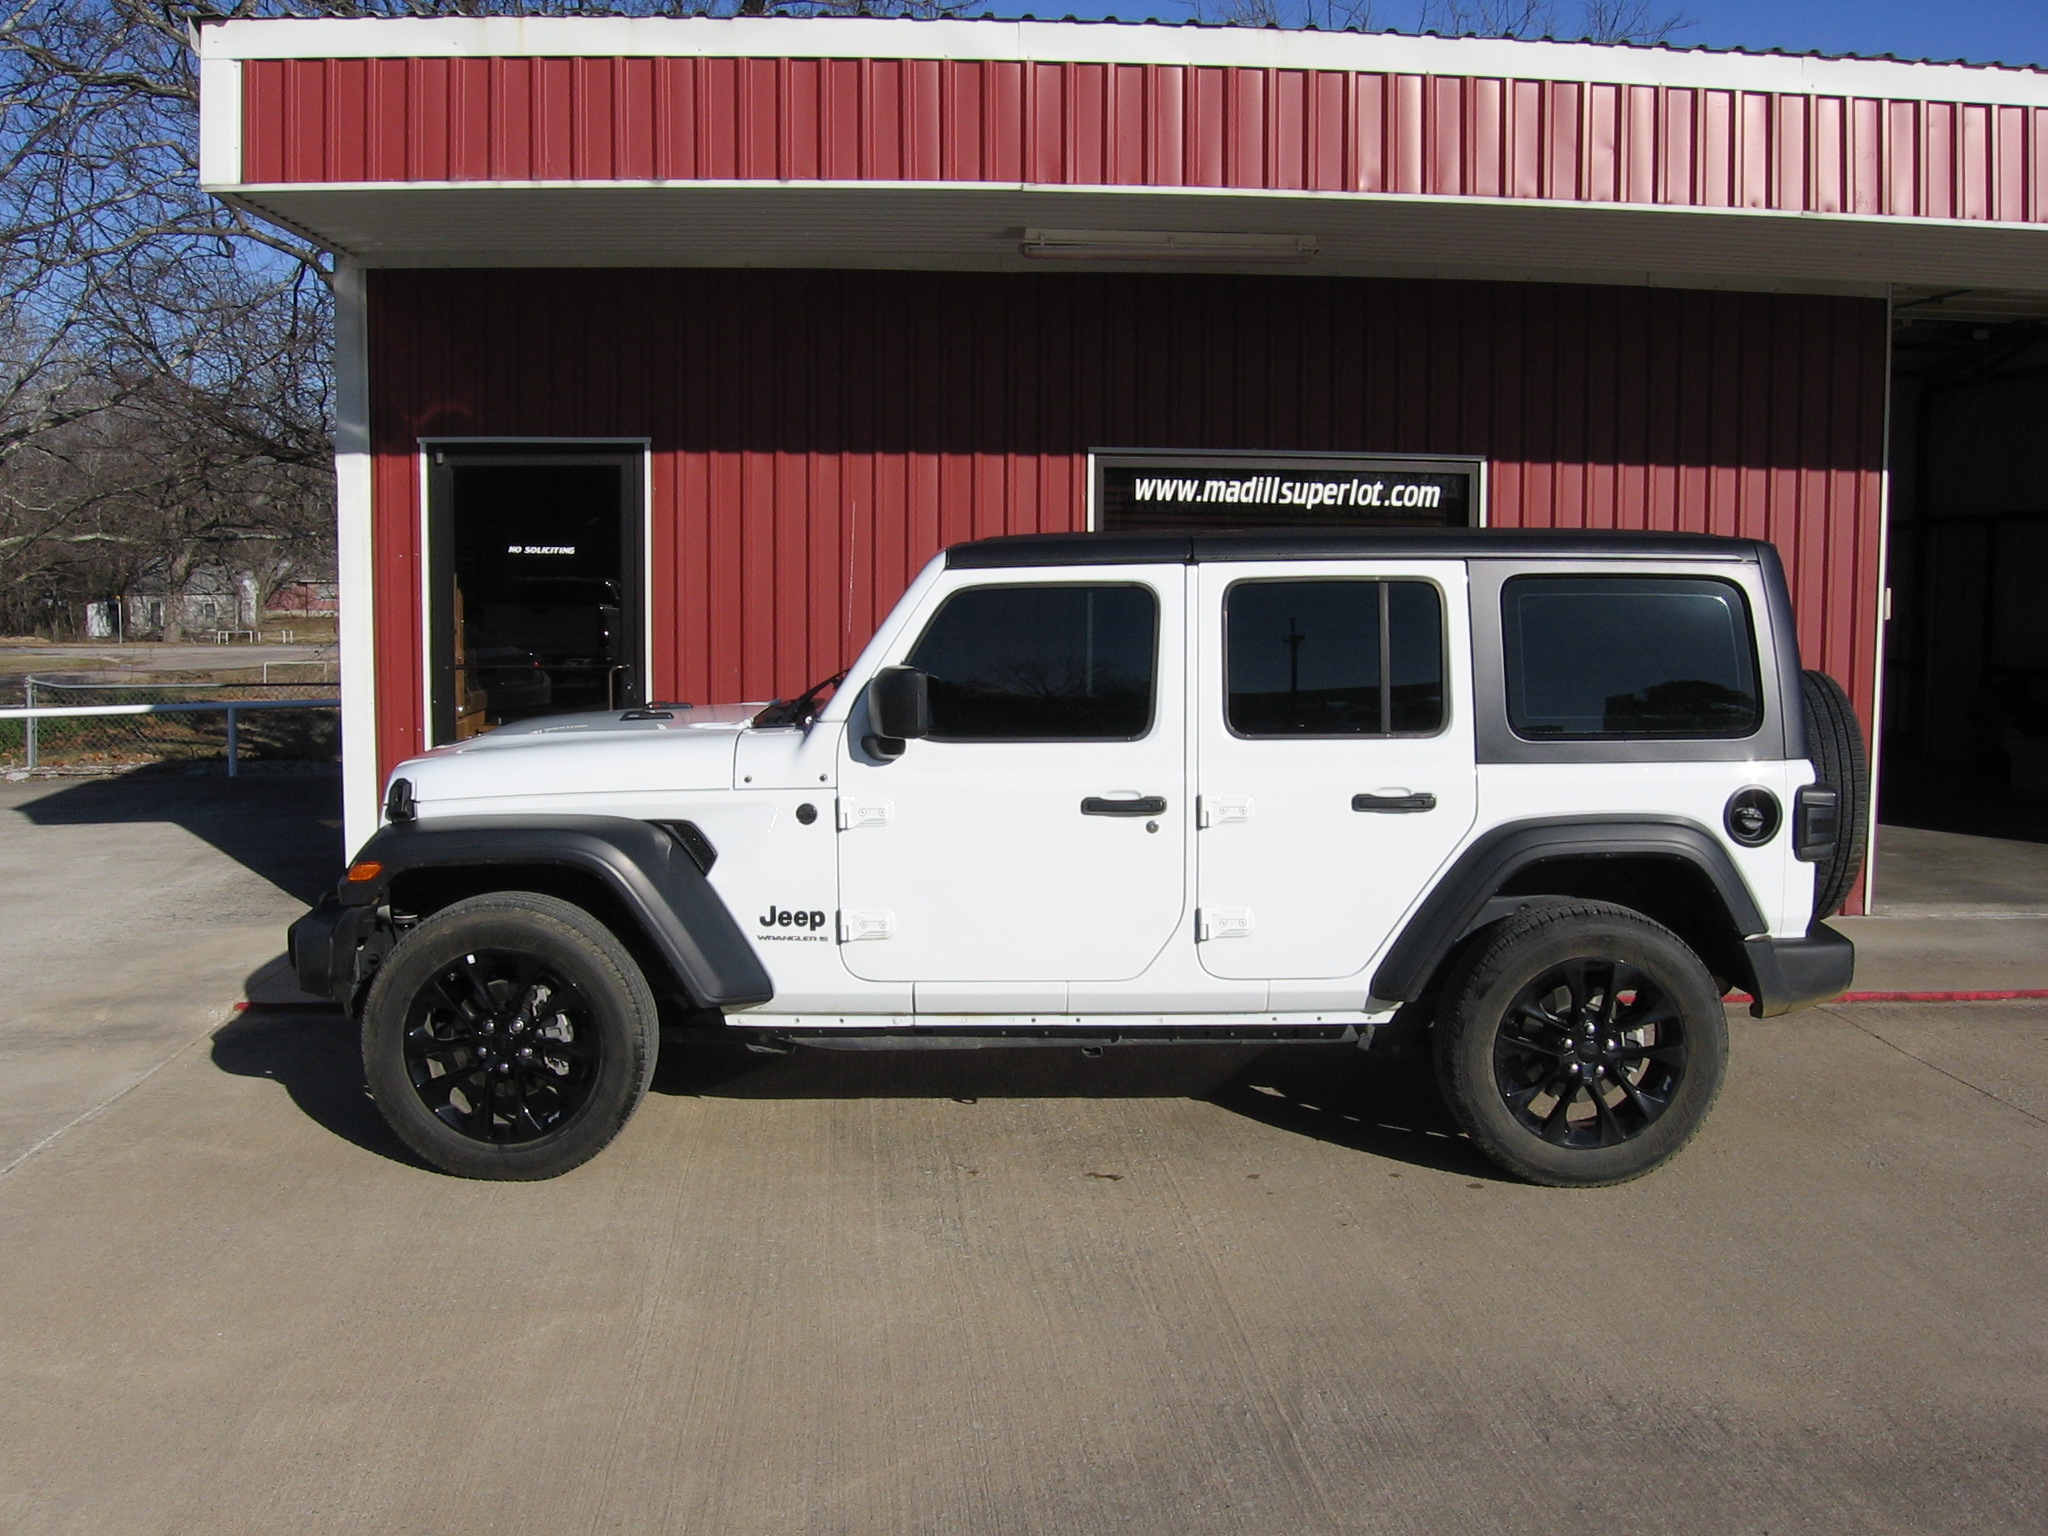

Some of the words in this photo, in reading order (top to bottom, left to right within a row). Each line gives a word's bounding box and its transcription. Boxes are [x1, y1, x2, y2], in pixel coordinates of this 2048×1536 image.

[1134, 476, 1441, 510] www.madillsuperlot.com
[508, 545, 522, 553] NO
[524, 546, 575, 555] SOLICITING
[759, 905, 826, 932] Jeep
